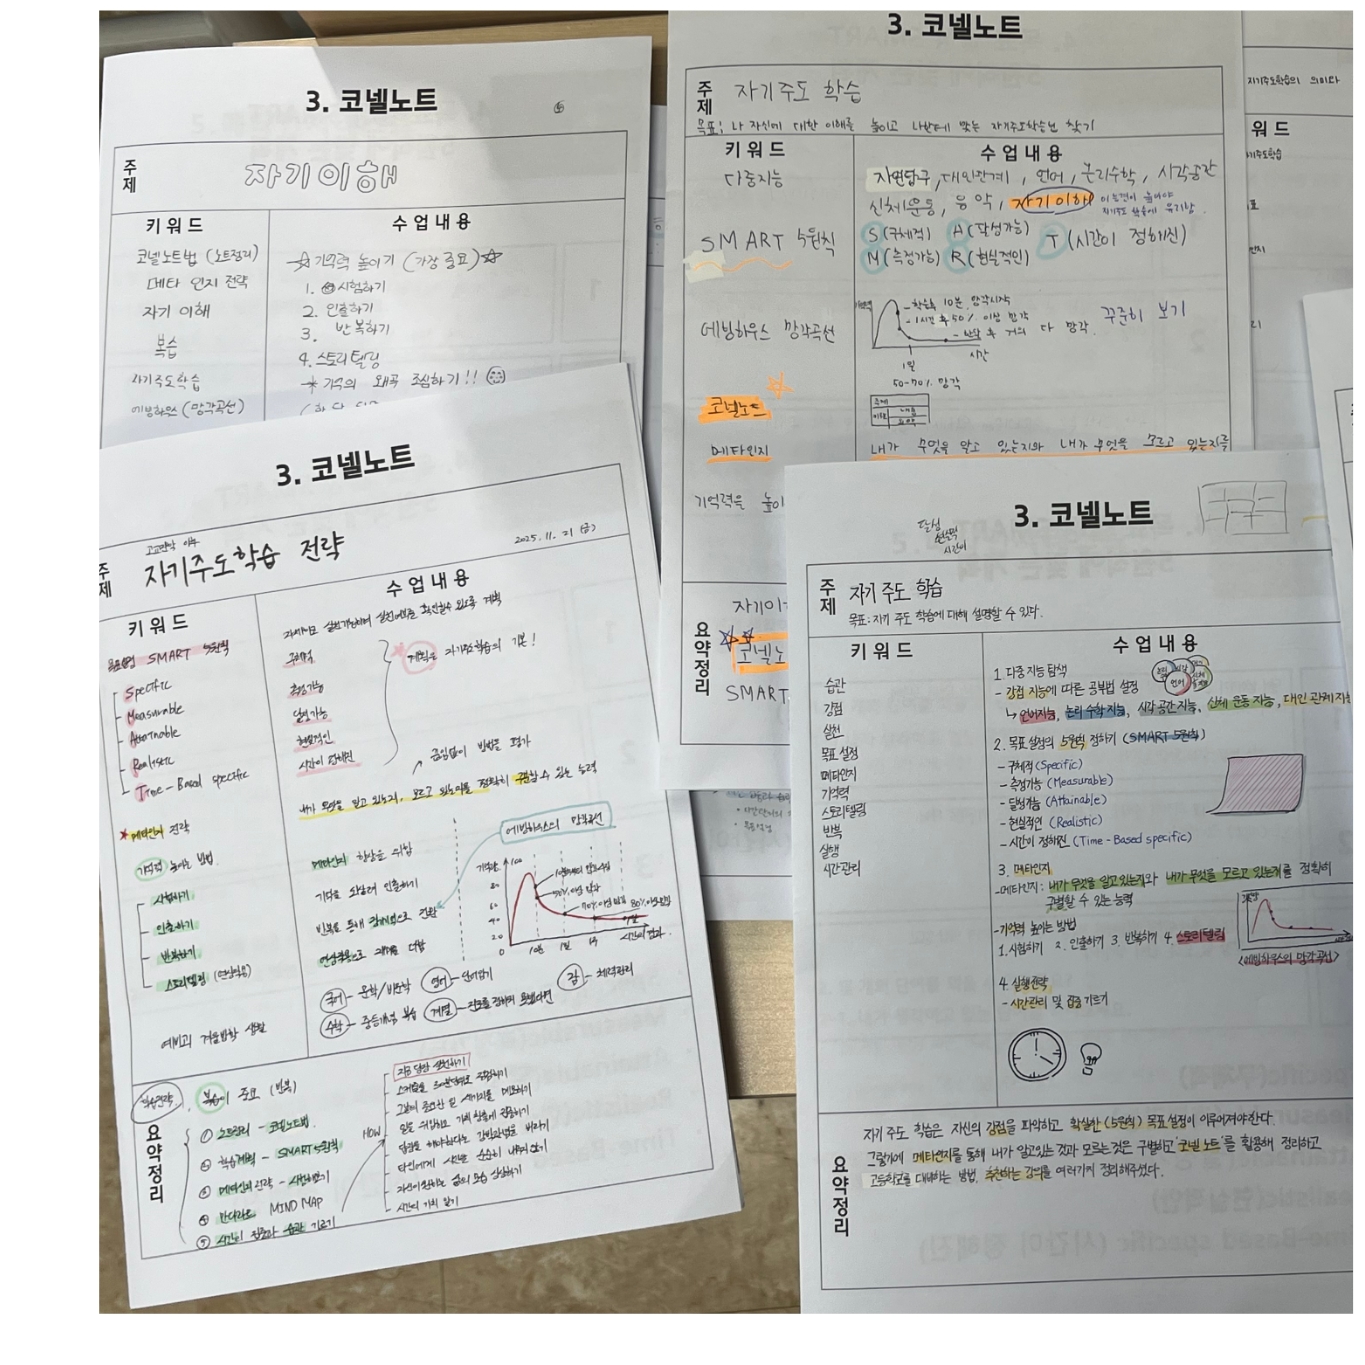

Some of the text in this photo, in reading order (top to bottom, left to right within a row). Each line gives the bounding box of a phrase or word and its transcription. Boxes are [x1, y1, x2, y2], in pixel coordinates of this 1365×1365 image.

[887, 12, 1024, 41] 3. 코넬노트
[306, 88, 438, 115] 3. 코넬노트
[736, 80, 862, 103] 자기주도 학습
[725, 140, 786, 159] 키워드
[980, 144, 1063, 162] 수업내용
[244, 160, 399, 193] 자기이해
[146, 217, 203, 234] 키워드
[392, 214, 471, 231] 수업내용
[702, 234, 785, 253] SMART
[142, 303, 211, 319] 자기 이해
[1158, 301, 1186, 319] 보기
[155, 336, 178, 358] 복습
[276, 444, 416, 486] 3. 코넬노트
[1014, 500, 1154, 528] 3. 코넬노트
[144, 531, 345, 589] 자기주도학습 전략
[386, 568, 470, 597] 수업내용
[849, 578, 943, 604] 자기 주도 학습
[128, 614, 189, 637] 키워드
[851, 641, 913, 660] 키워드
[1113, 633, 1198, 654] 수업내용
[125, 680, 172, 700] Specific
[824, 677, 846, 695] 습관
[1035, 758, 1083, 772] (Specific)
[1046, 774, 1113, 789] (Measurable)
[1045, 792, 1107, 807] (Attainable)
[1049, 814, 1103, 828] (Realistic)
[145, 1124, 165, 1204] 요약정리
[269, 1196, 323, 1216] MIND MAP
[833, 1156, 850, 1237] 요약정리
